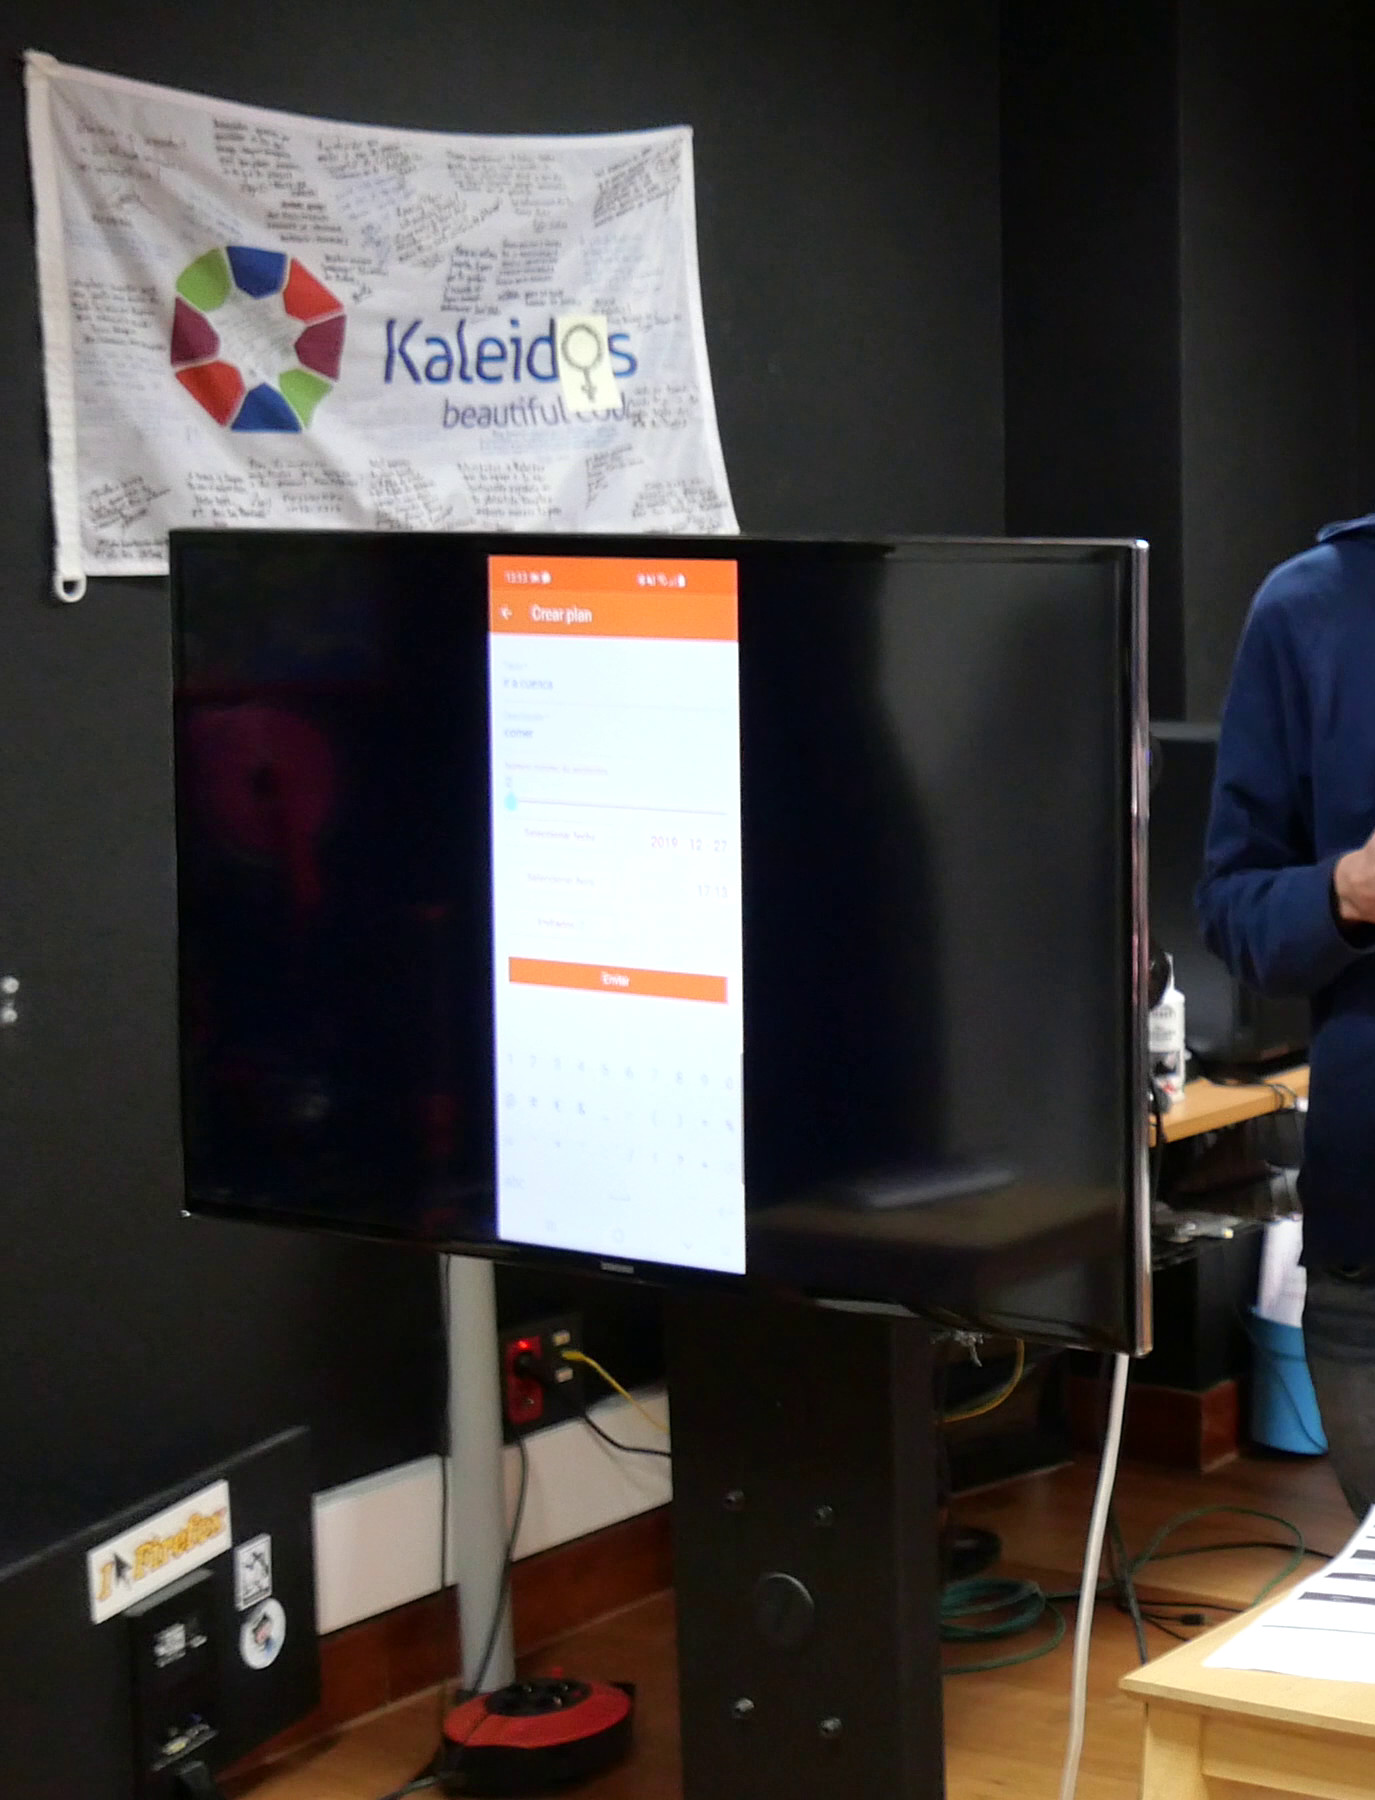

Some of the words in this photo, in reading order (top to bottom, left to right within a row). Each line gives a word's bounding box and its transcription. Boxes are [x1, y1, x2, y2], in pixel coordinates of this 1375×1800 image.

[384, 318, 638, 385] Kaleids
[442, 396, 570, 429] beautiful
[531, 603, 564, 623] Crear
[566, 604, 593, 625] plan
